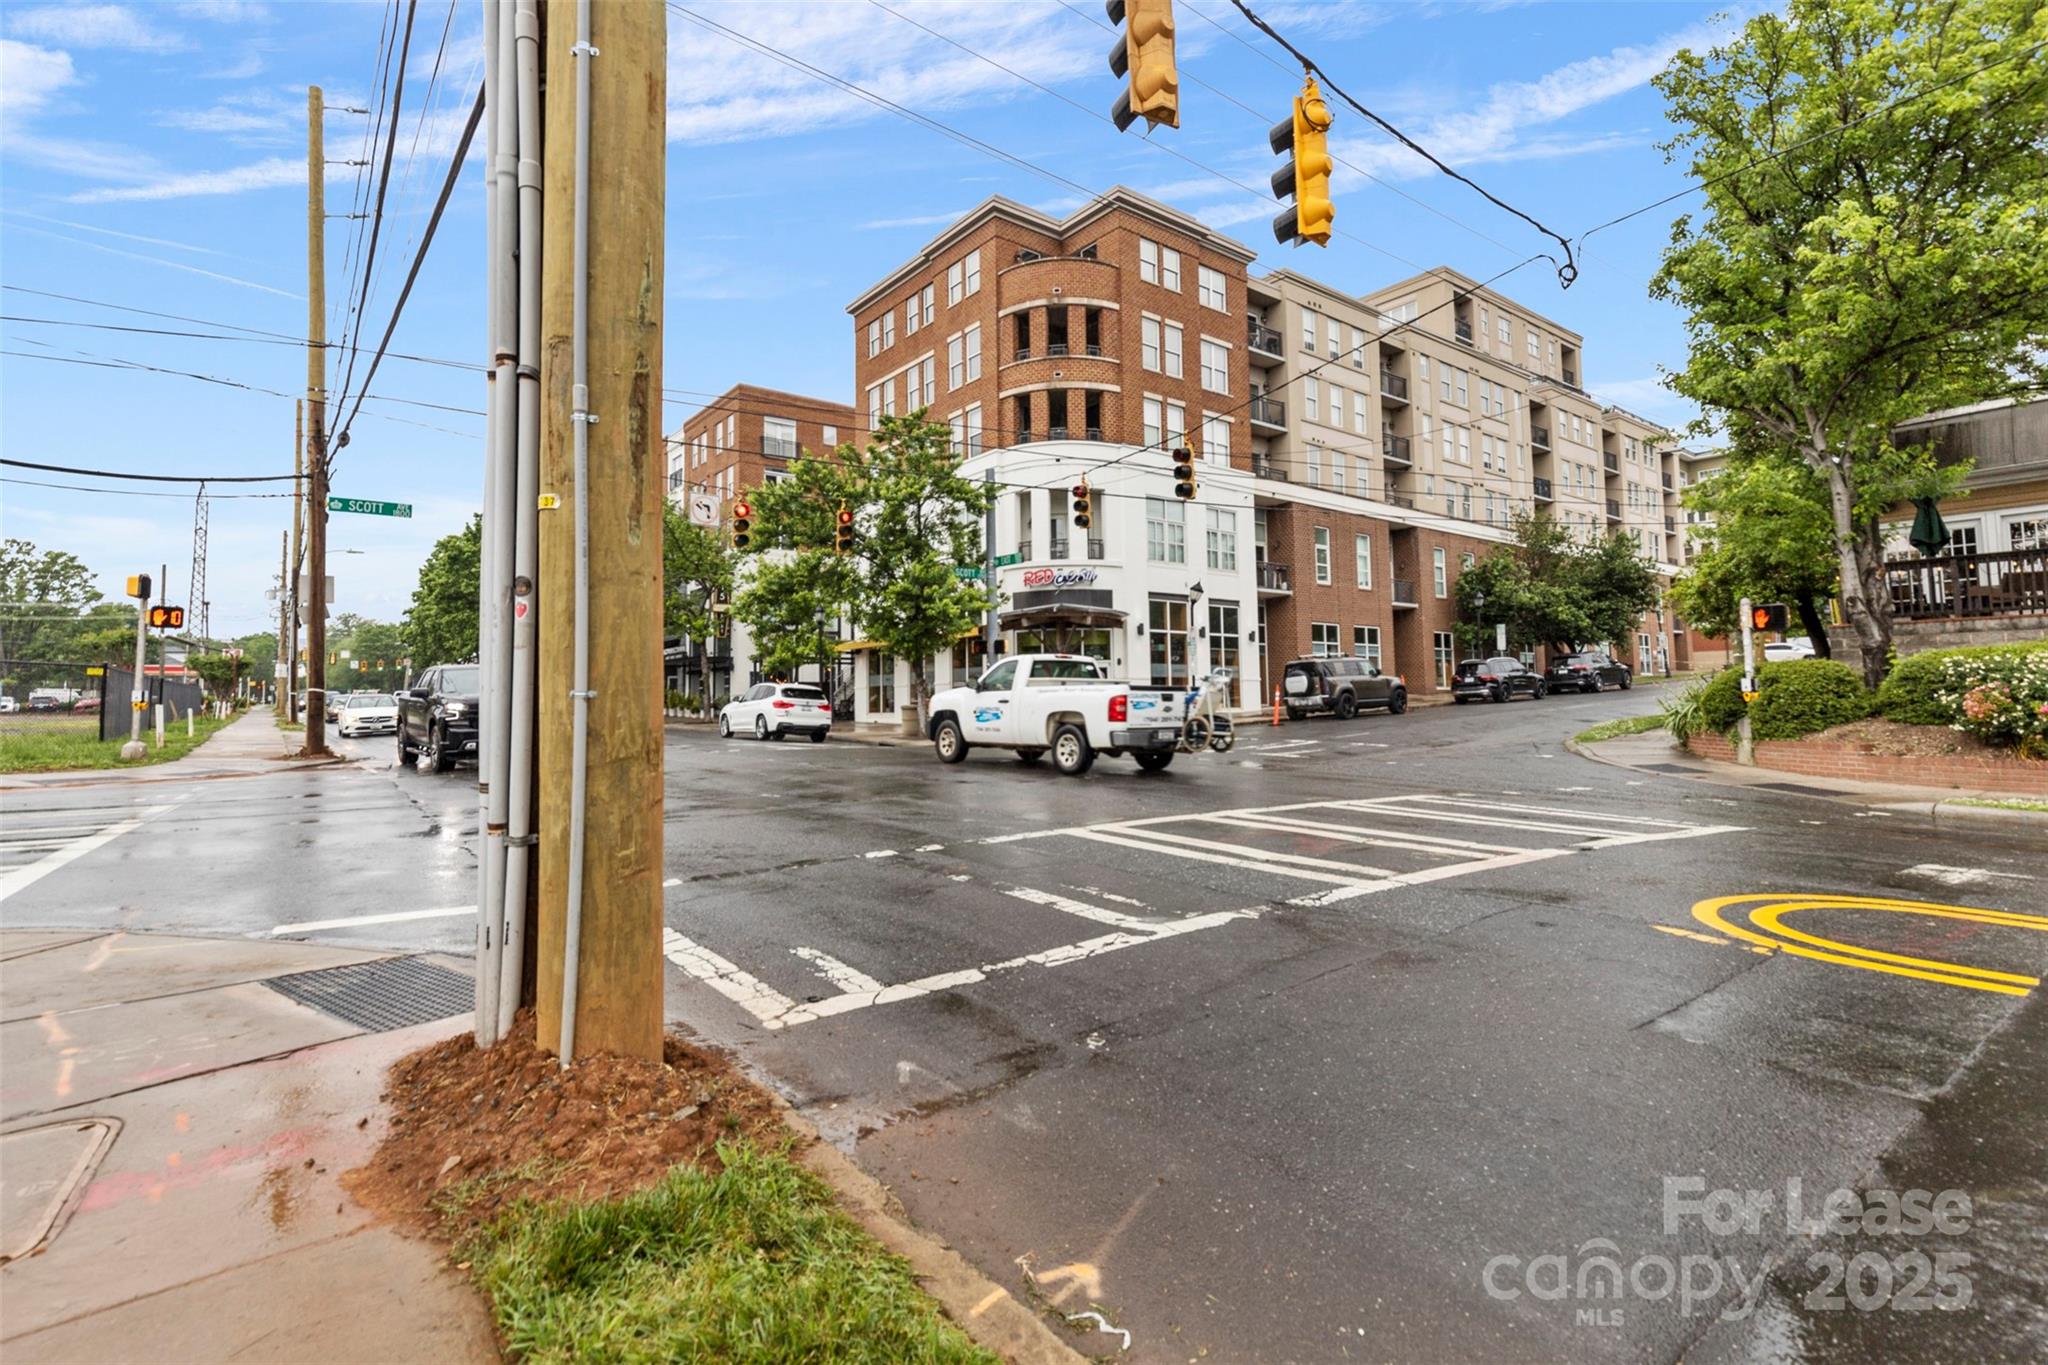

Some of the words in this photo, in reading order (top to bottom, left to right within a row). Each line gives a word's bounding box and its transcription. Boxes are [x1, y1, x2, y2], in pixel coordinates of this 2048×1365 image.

[348, 500, 384, 513] SCOTT
[955, 567, 976, 578] SCOTT
[1023, 568, 1054, 587] RED
